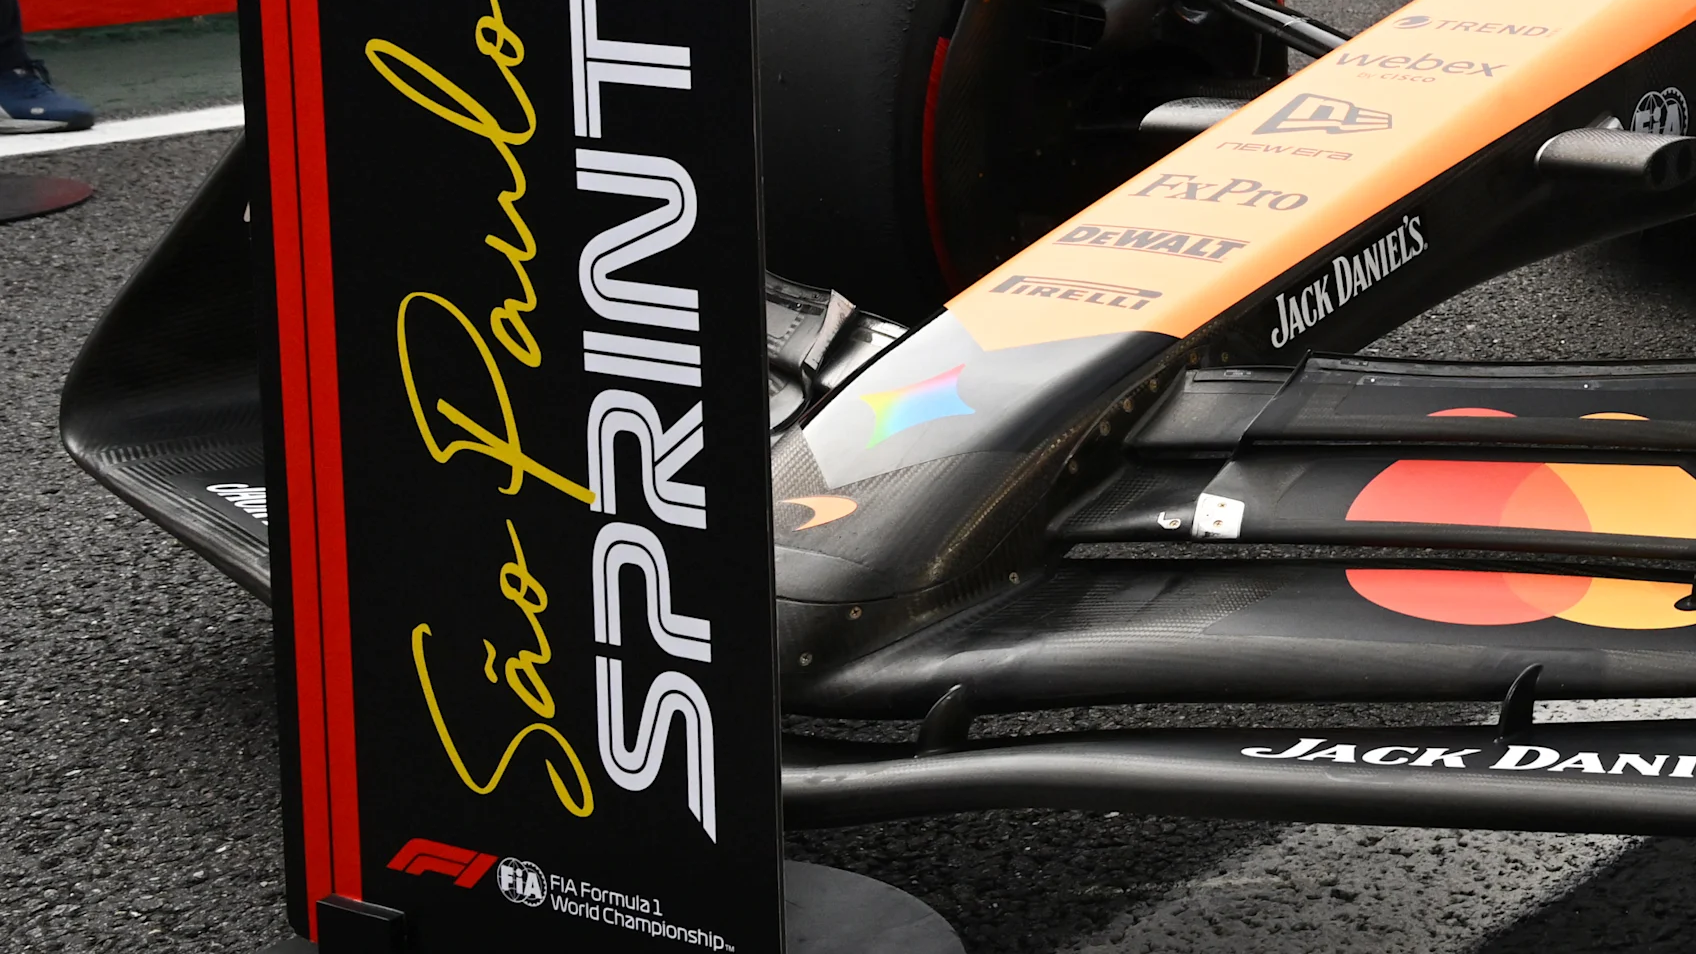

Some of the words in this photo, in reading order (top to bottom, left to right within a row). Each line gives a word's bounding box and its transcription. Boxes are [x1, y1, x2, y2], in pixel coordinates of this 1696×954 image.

[1427, 18, 1549, 38] TREND
[1336, 52, 1509, 78] webex
[1128, 173, 1309, 211] FxPro
[989, 275, 1163, 311] PIRELLI
[1271, 276, 1335, 349] JACK
[1332, 214, 1428, 308] DANIEL'S
[1240, 737, 1482, 768] JACK
[550, 874, 577, 896] FIA
[580, 881, 651, 914] Formula
[652, 898, 664, 917] 1
[550, 893, 600, 922] World
